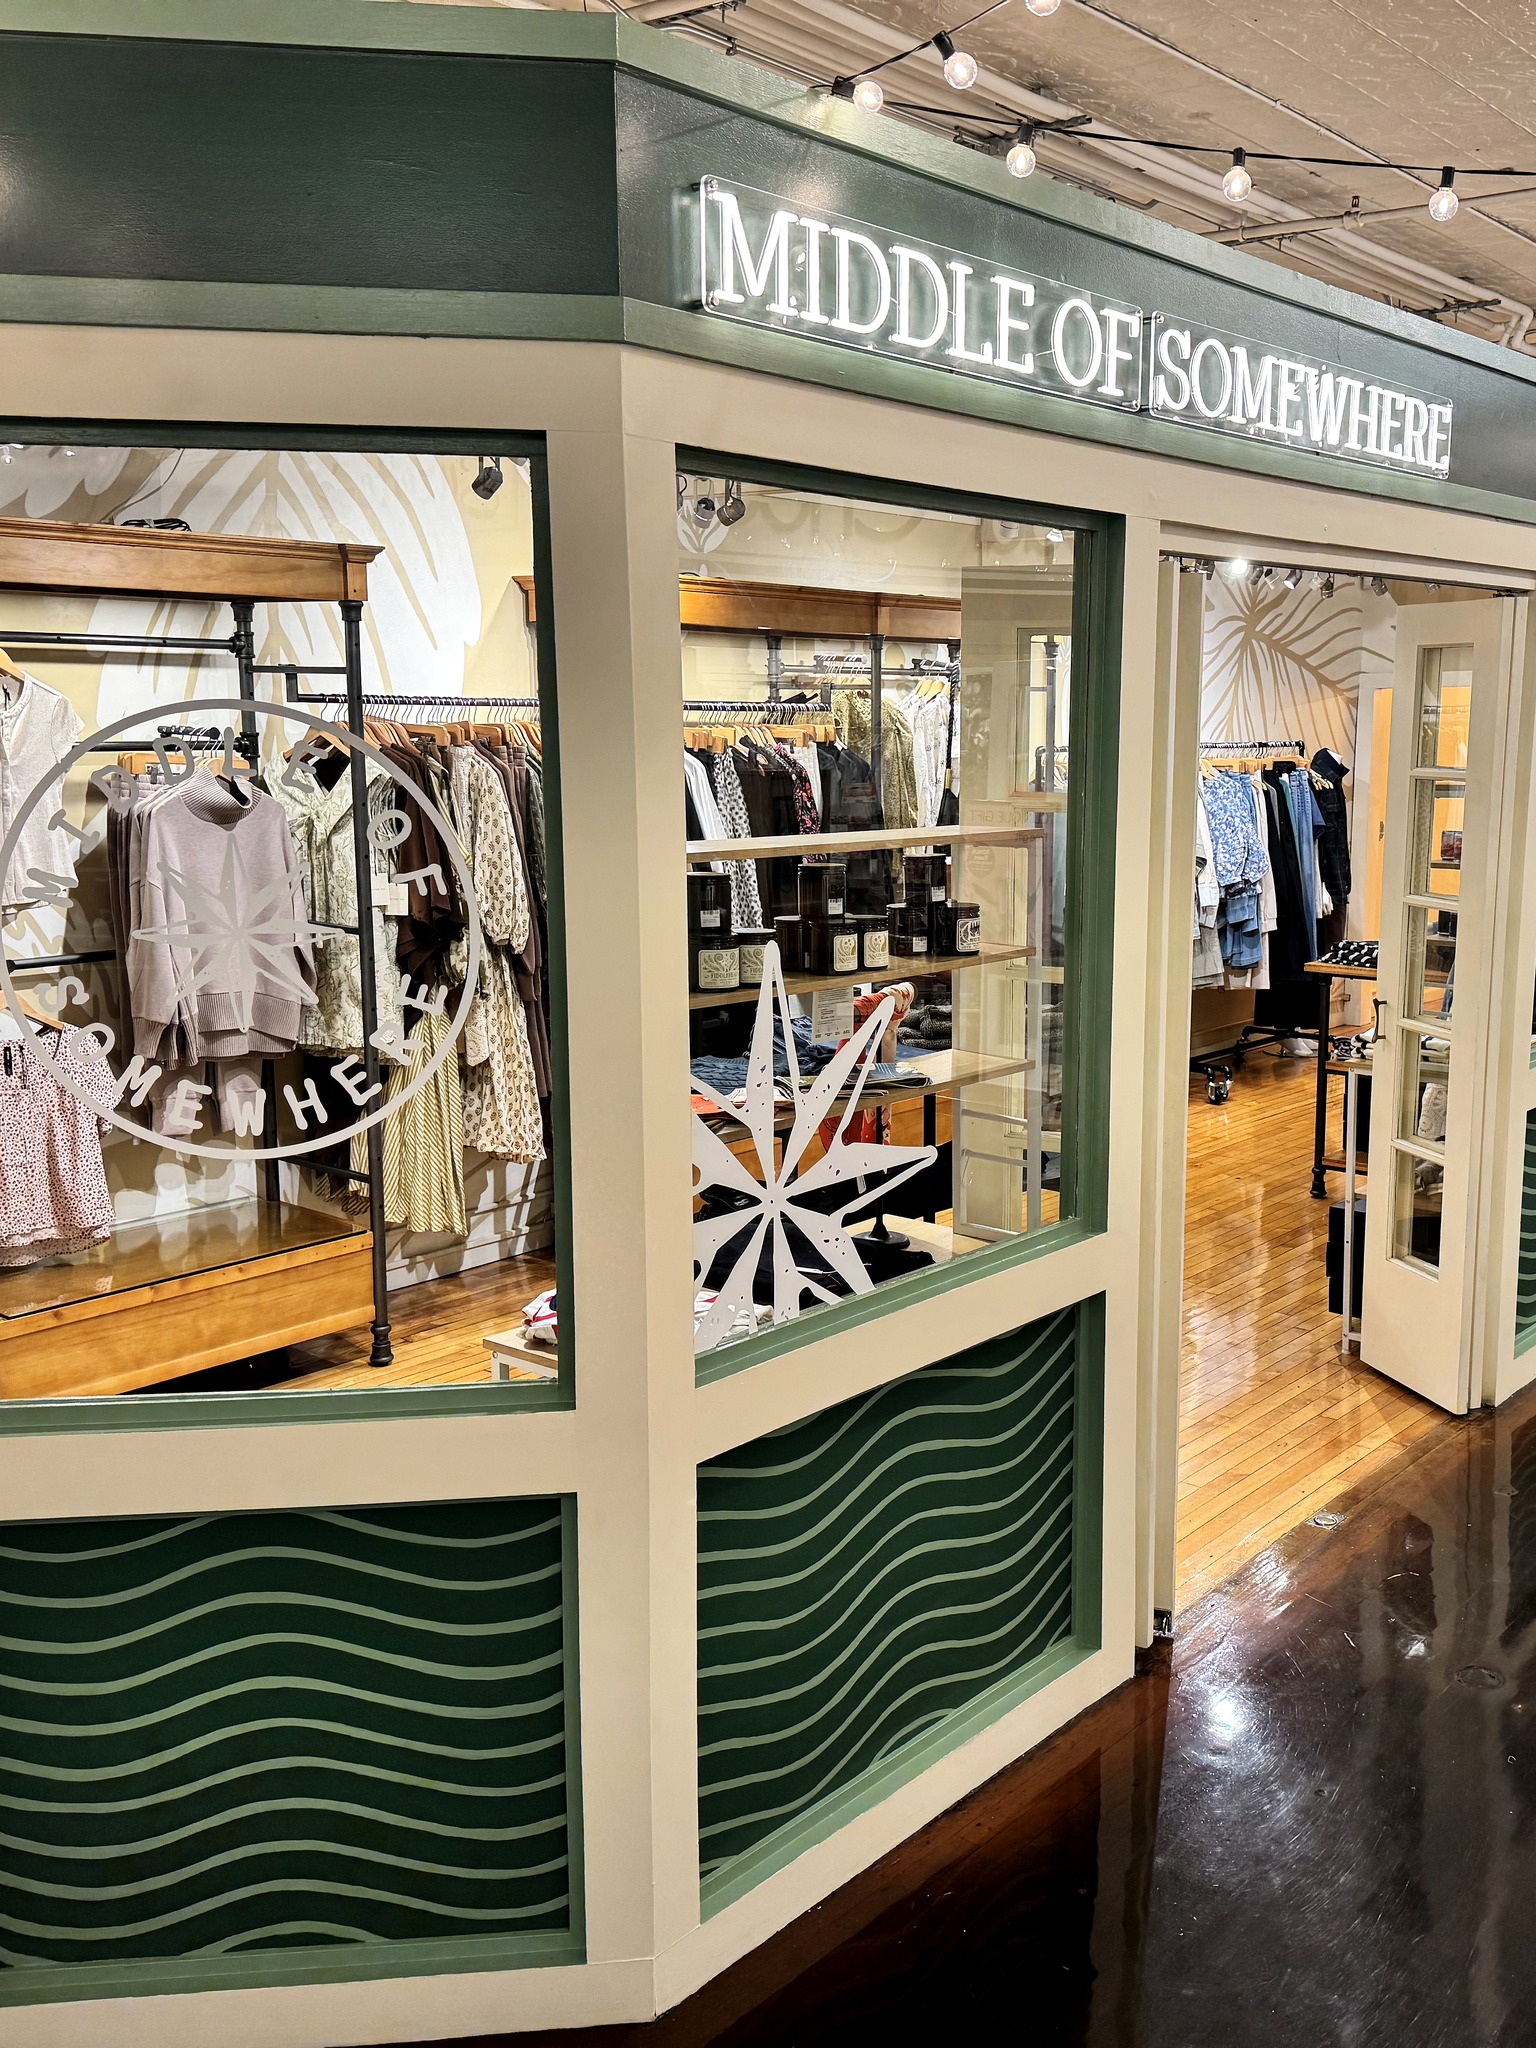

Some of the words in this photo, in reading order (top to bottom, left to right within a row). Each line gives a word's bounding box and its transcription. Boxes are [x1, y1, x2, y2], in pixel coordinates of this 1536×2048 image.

[711, 193, 1035, 373] MIDDLE
[1051, 299, 1140, 397] OF
[1153, 328, 1454, 472] SOMEWHERE
[22, 727, 328, 908] MIDDLE
[366, 810, 447, 896] OF
[33, 974, 448, 1137] SOMEWHERE
